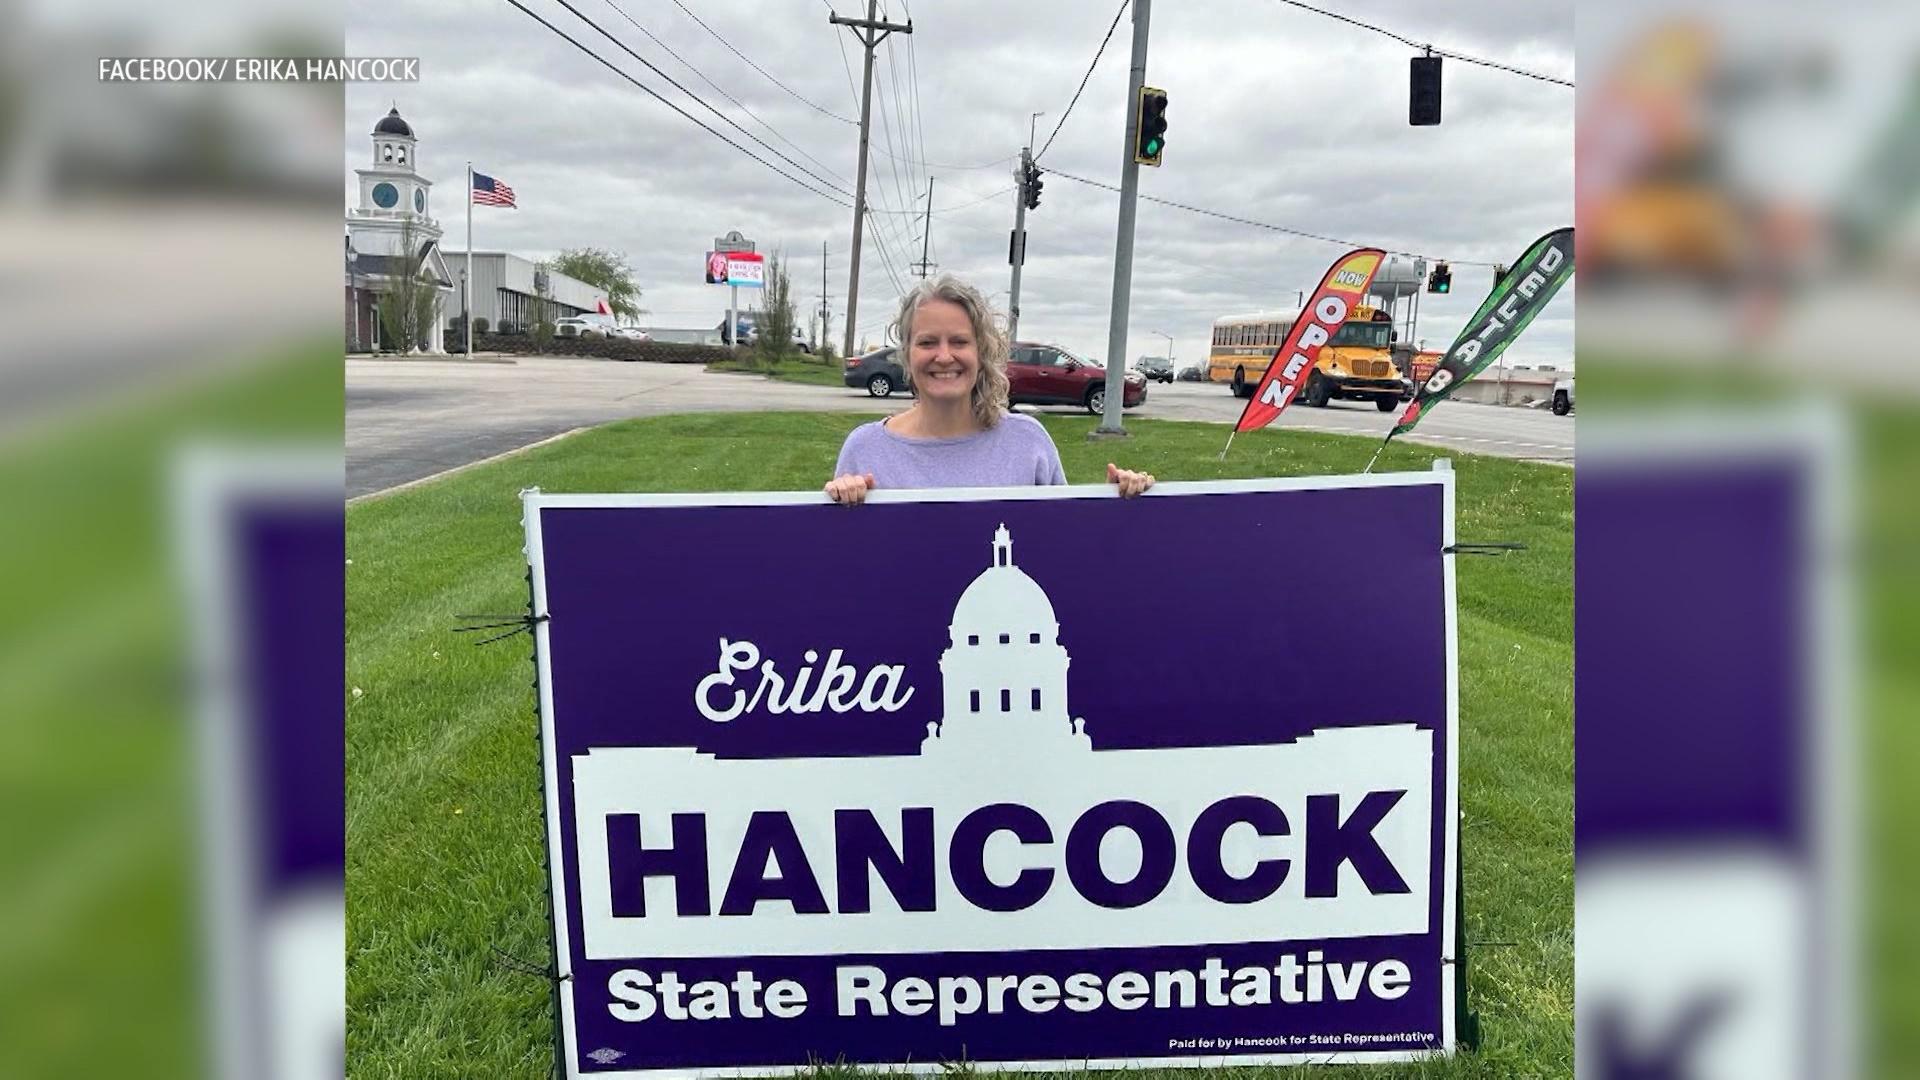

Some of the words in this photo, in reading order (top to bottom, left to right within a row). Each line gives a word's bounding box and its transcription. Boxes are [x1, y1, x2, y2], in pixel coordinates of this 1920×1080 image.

[1335, 271, 1368, 287] NOW
[1454, 245, 1564, 365] DELTA
[1260, 295, 1348, 409] OPEN
[694, 637, 915, 722] Erika
[605, 789, 1413, 919] HANCOCK
[607, 968, 808, 1022] State
[836, 950, 1412, 1026] Representative
[1169, 1039, 1196, 1049] Paid
[1198, 1037, 1215, 1048] for
[1217, 1037, 1233, 1050] by
[1234, 1036, 1287, 1047] Hancock
[1289, 1035, 1308, 1045] for
[1309, 1034, 1342, 1045] State
[1343, 1031, 1435, 1046] Representative
